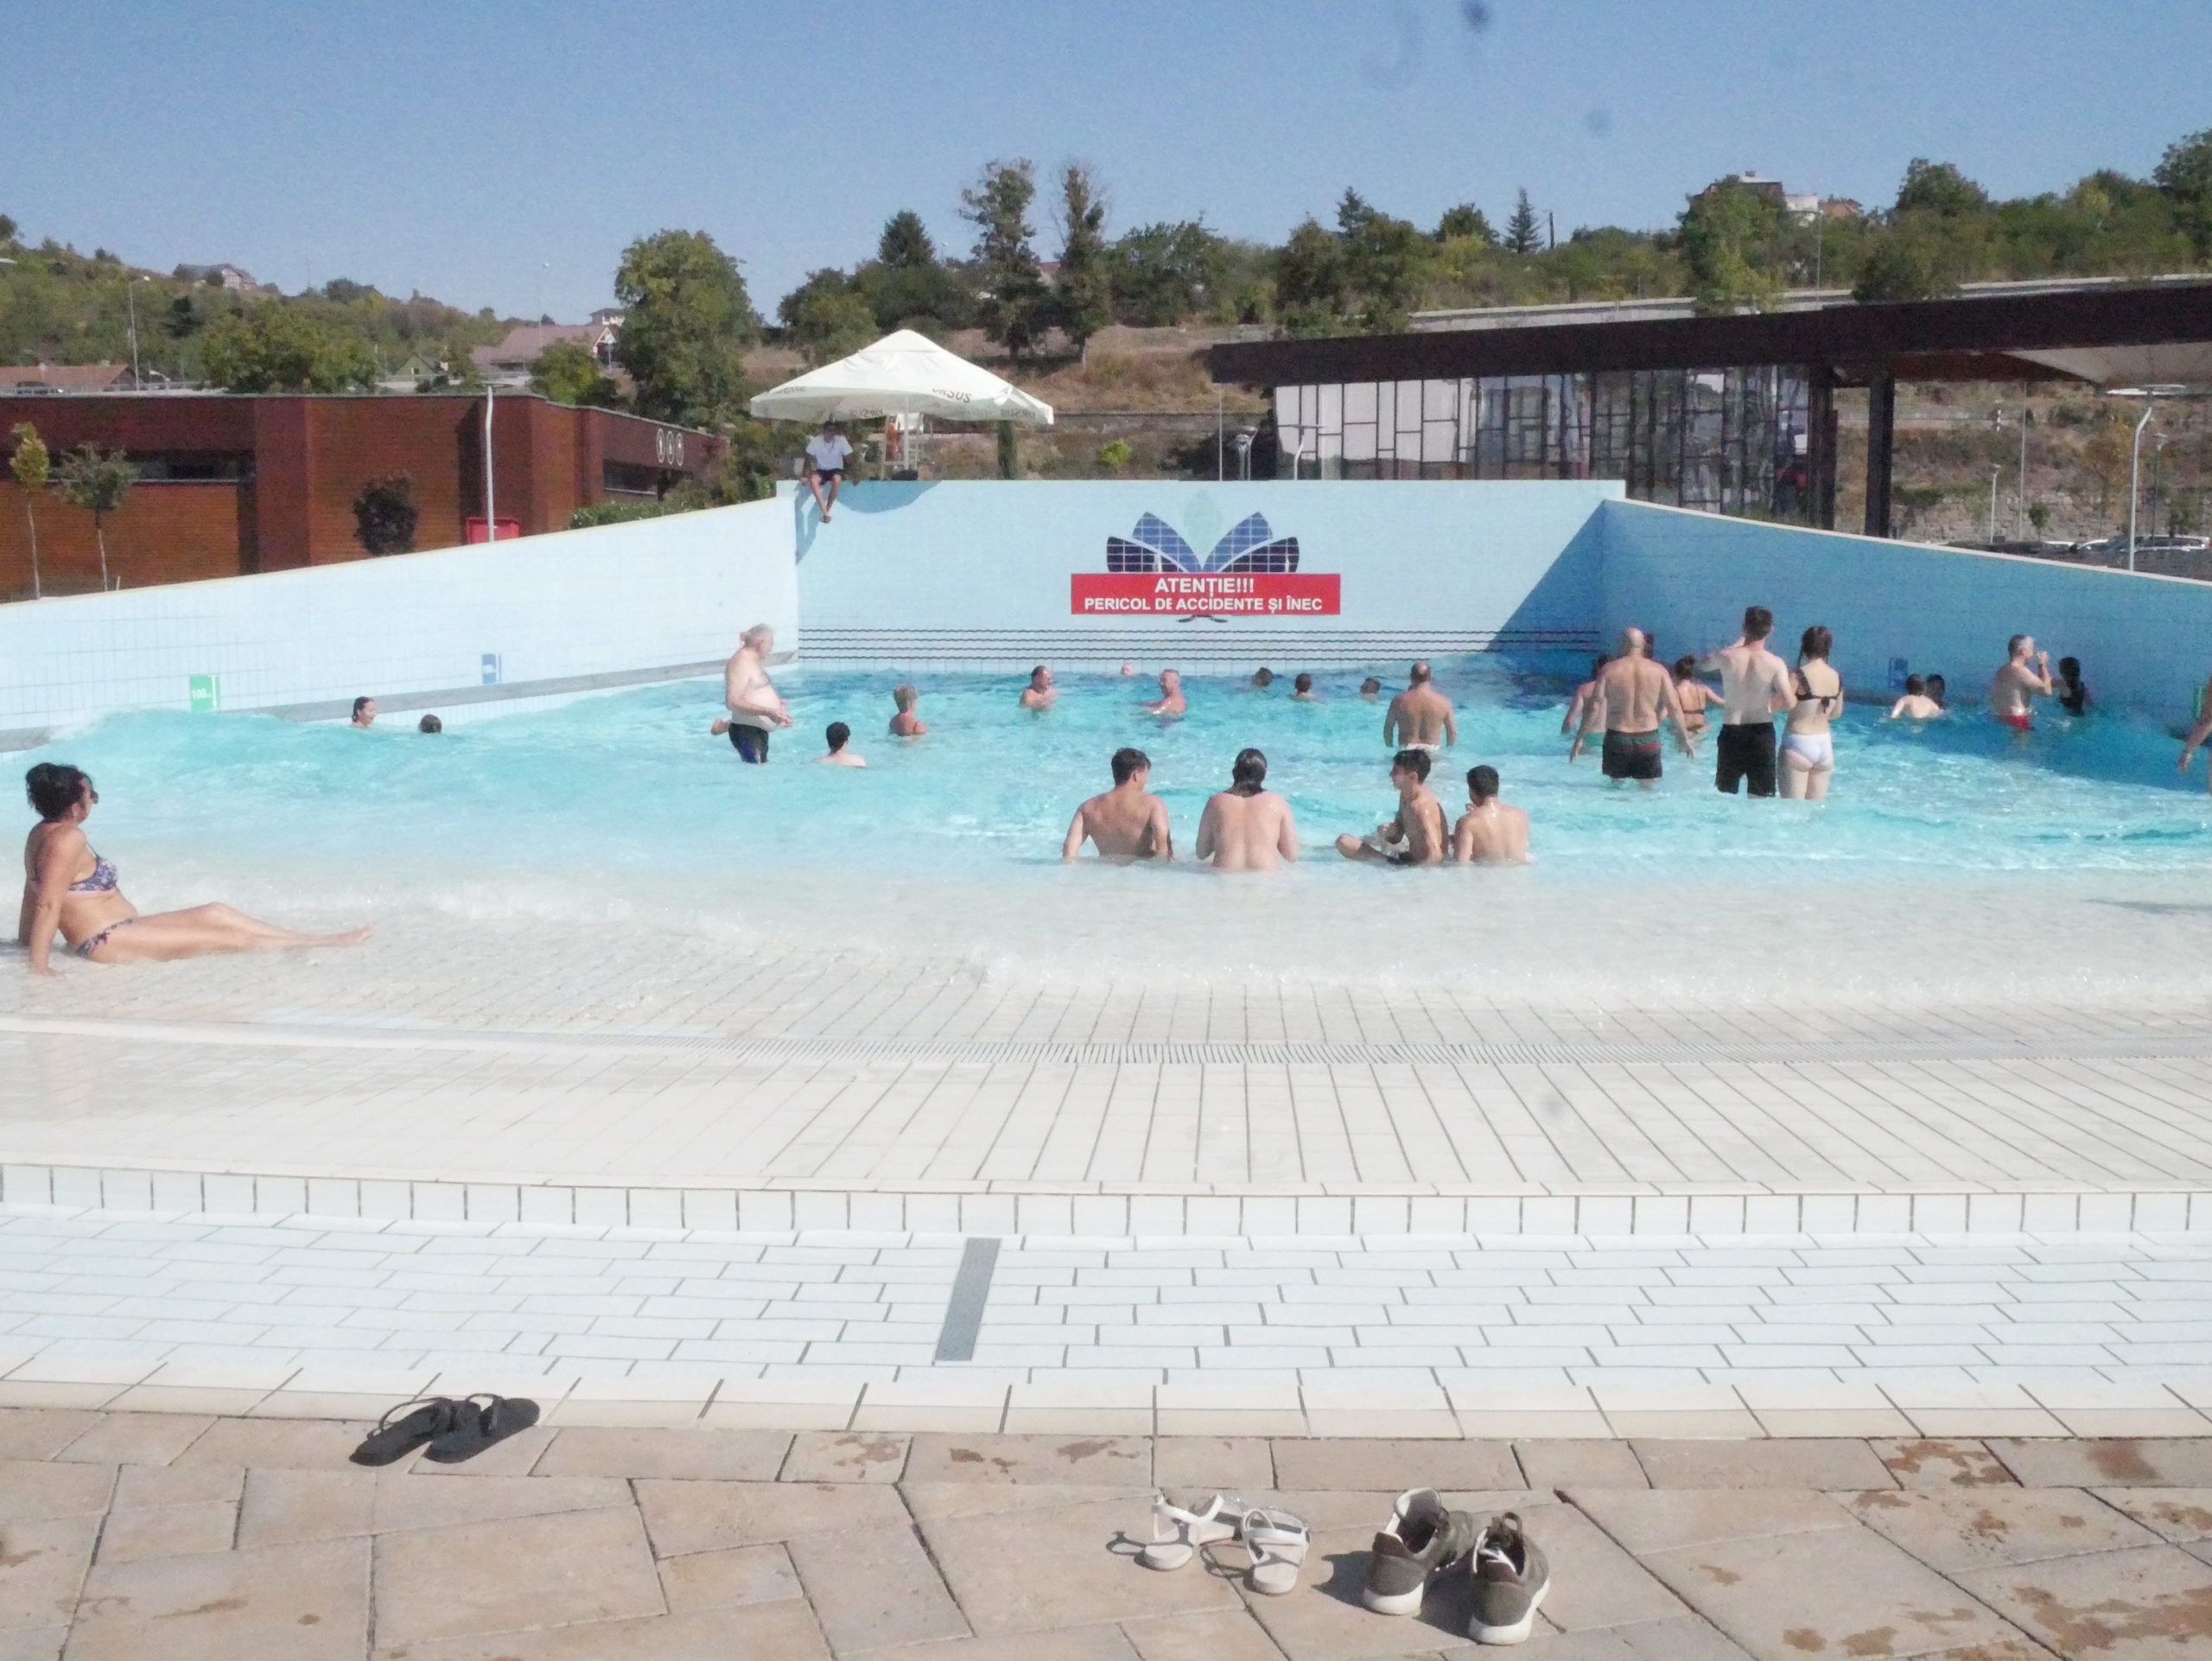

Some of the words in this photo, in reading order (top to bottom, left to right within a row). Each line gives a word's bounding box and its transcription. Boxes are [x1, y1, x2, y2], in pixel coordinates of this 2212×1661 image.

[1084, 597, 1151, 610] PERICOL
[1154, 597, 1173, 610] DE
[1175, 597, 1264, 610] ACCIDENTE
[1286, 595, 1323, 610] ÎNEC
